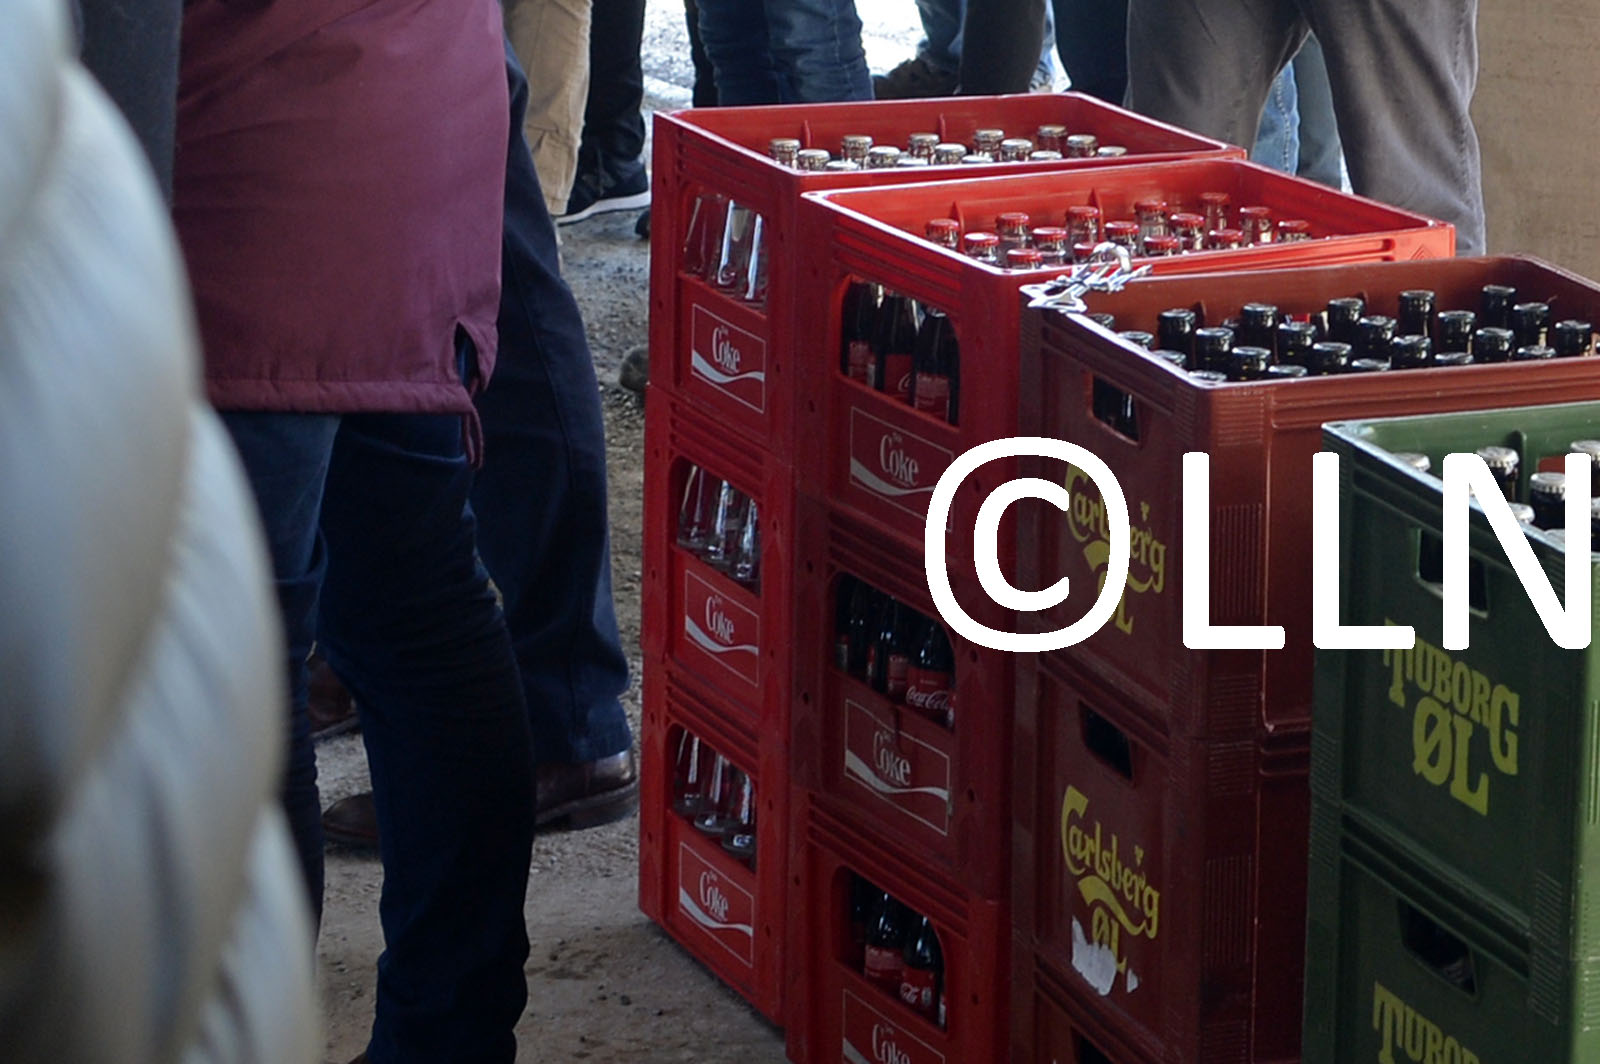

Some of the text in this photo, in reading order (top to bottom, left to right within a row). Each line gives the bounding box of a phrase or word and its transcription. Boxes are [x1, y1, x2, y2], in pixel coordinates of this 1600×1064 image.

[712, 327, 741, 374] Coke
[880, 434, 919, 487] Coke
[1066, 459, 1167, 593] Carlerg
[706, 596, 734, 645] Coke
[1383, 616, 1520, 776] TUBORG
[873, 730, 911, 786] Coke
[1061, 784, 1160, 939] Carlsberg
[700, 871, 728, 922] Coke
